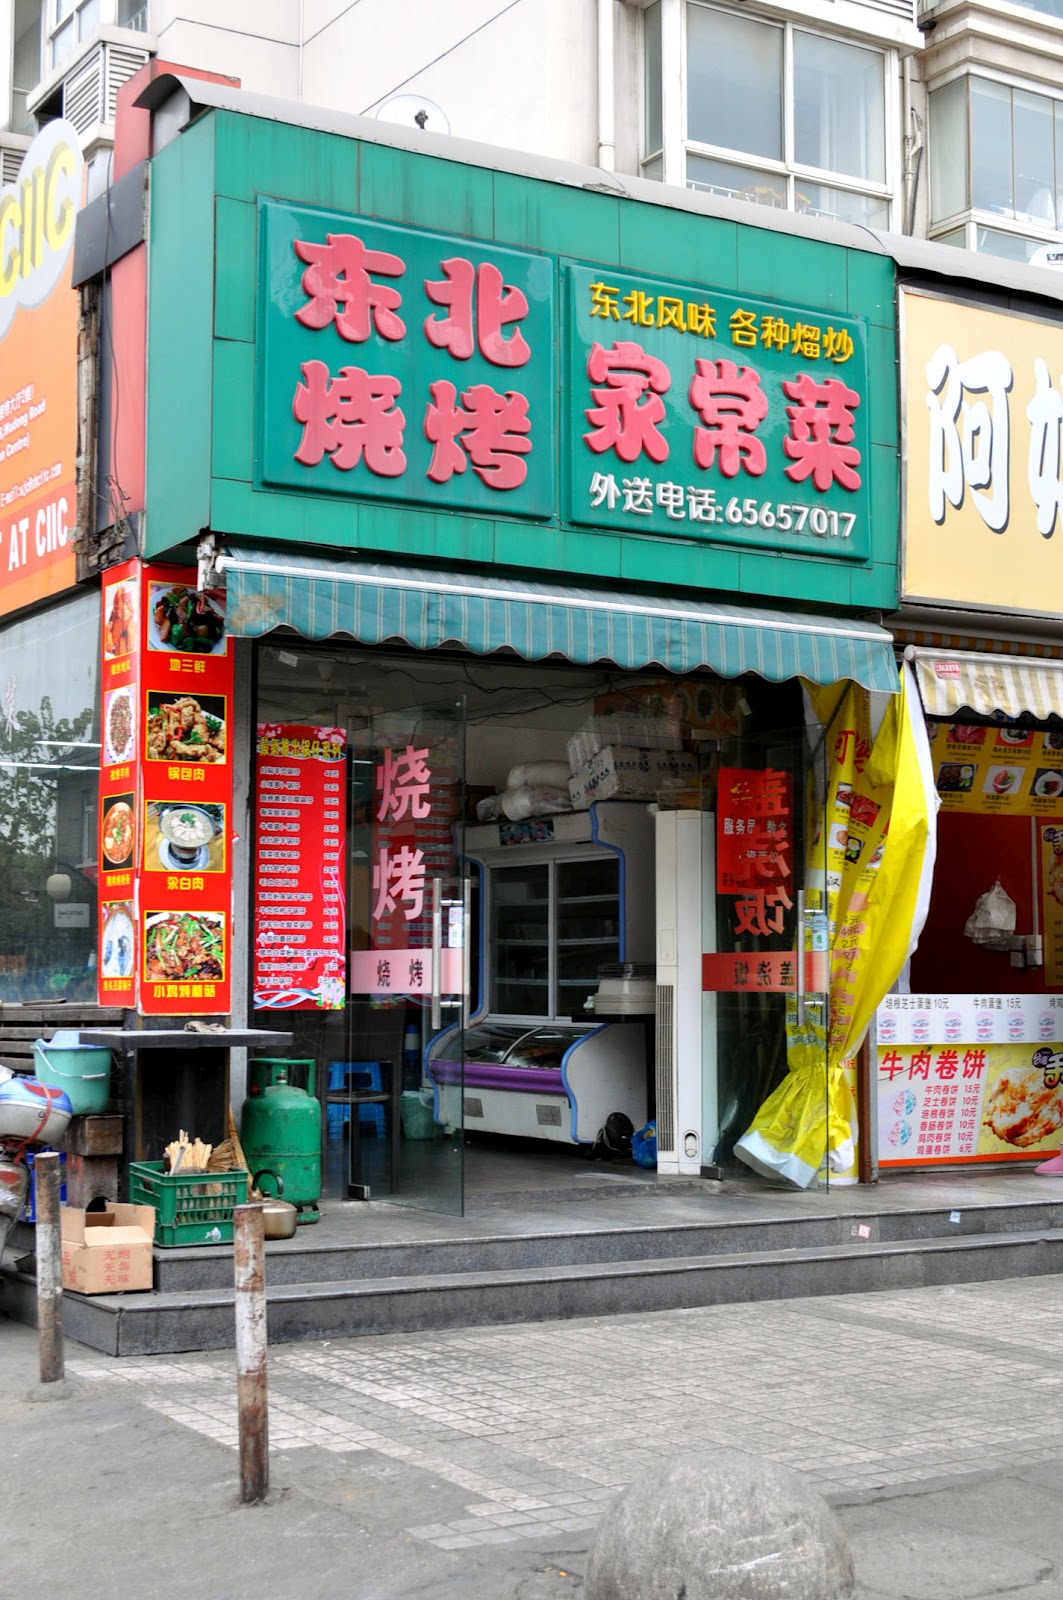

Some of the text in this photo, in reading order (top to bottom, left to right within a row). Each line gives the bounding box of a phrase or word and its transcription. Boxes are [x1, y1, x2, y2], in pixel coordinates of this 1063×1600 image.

[293, 233, 530, 369] 东北
[589, 282, 854, 363] 东北风味 各种熘炒
[293, 360, 532, 491] 烧烤
[583, 341, 862, 492] 家常菜
[8, 497, 68, 572] AT CIIC
[168, 766, 205, 781] 锅包肉
[373, 745, 431, 921] 烧烤
[377, 959, 424, 988] 烧烤
[879, 1048, 986, 1082] 牛肉卷饼
